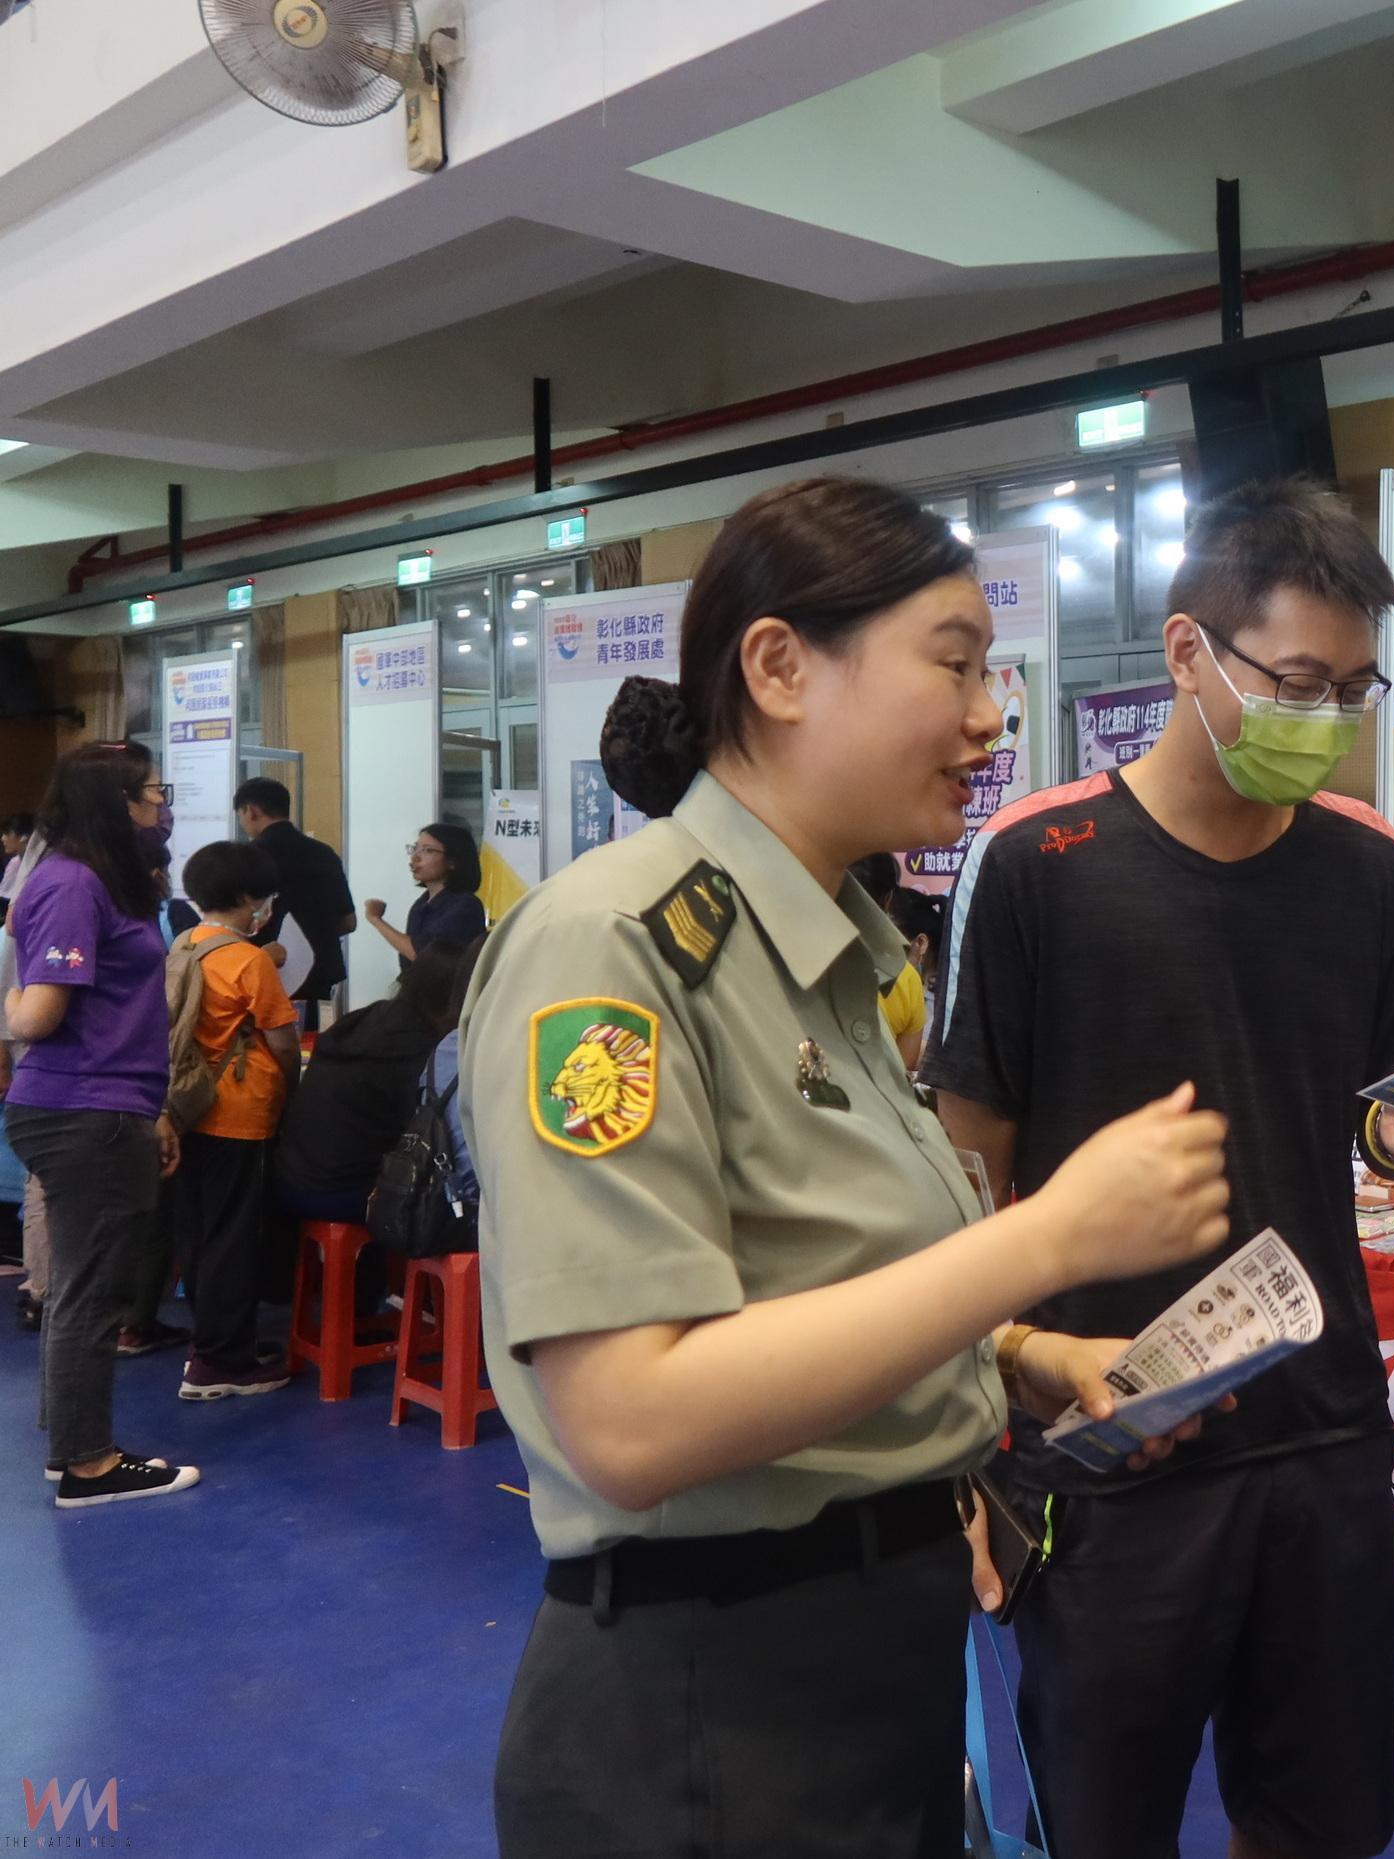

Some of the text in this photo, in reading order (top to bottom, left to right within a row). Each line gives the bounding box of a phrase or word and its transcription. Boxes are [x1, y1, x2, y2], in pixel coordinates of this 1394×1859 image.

[597, 612, 664, 639] 彰化縣政府
[597, 638, 664, 664] 青年發展處
[1256, 1284, 1280, 1318] ROAD
